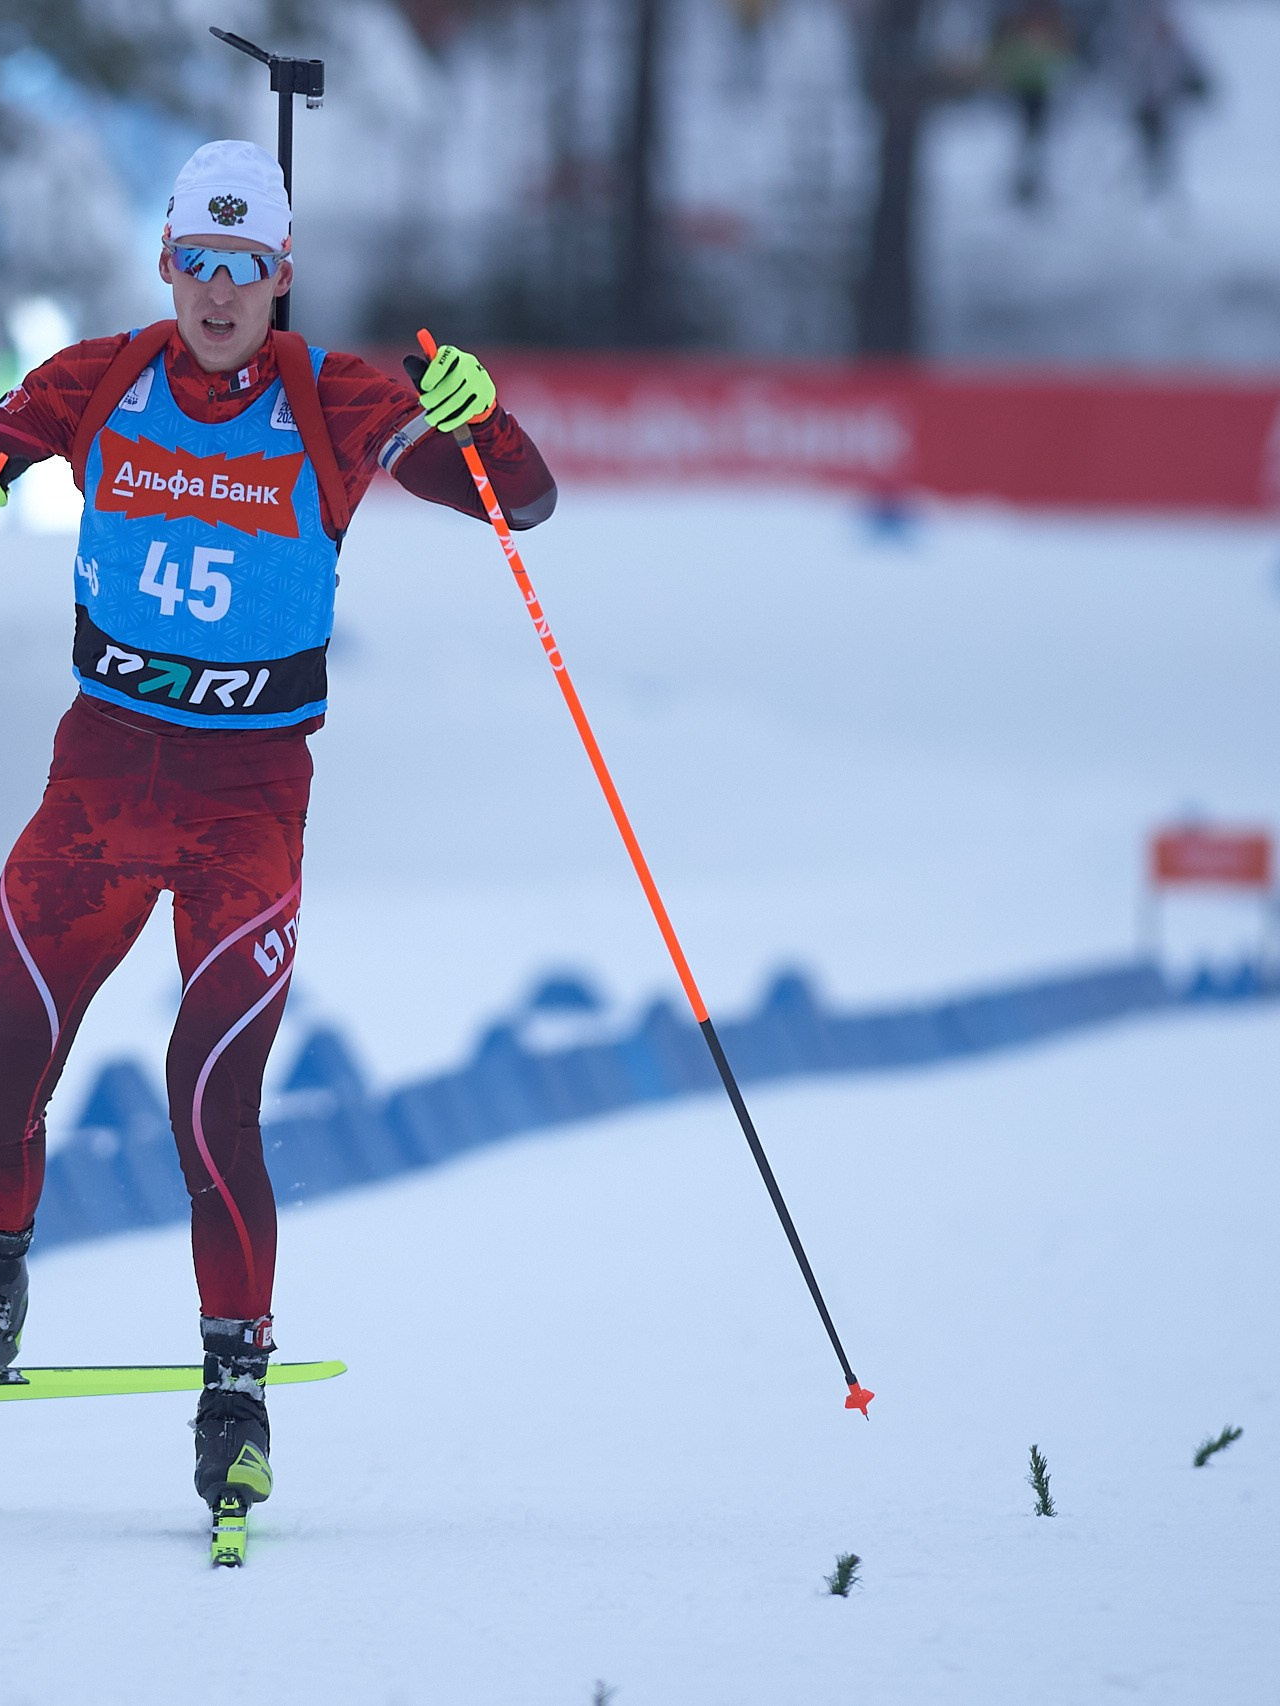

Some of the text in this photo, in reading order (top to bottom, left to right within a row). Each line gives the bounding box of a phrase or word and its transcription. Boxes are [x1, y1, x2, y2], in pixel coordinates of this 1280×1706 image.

[112, 461, 280, 505] Альфа Банк
[77, 555, 99, 597] 45
[138, 540, 235, 622] 45
[95, 644, 271, 708] PARI
